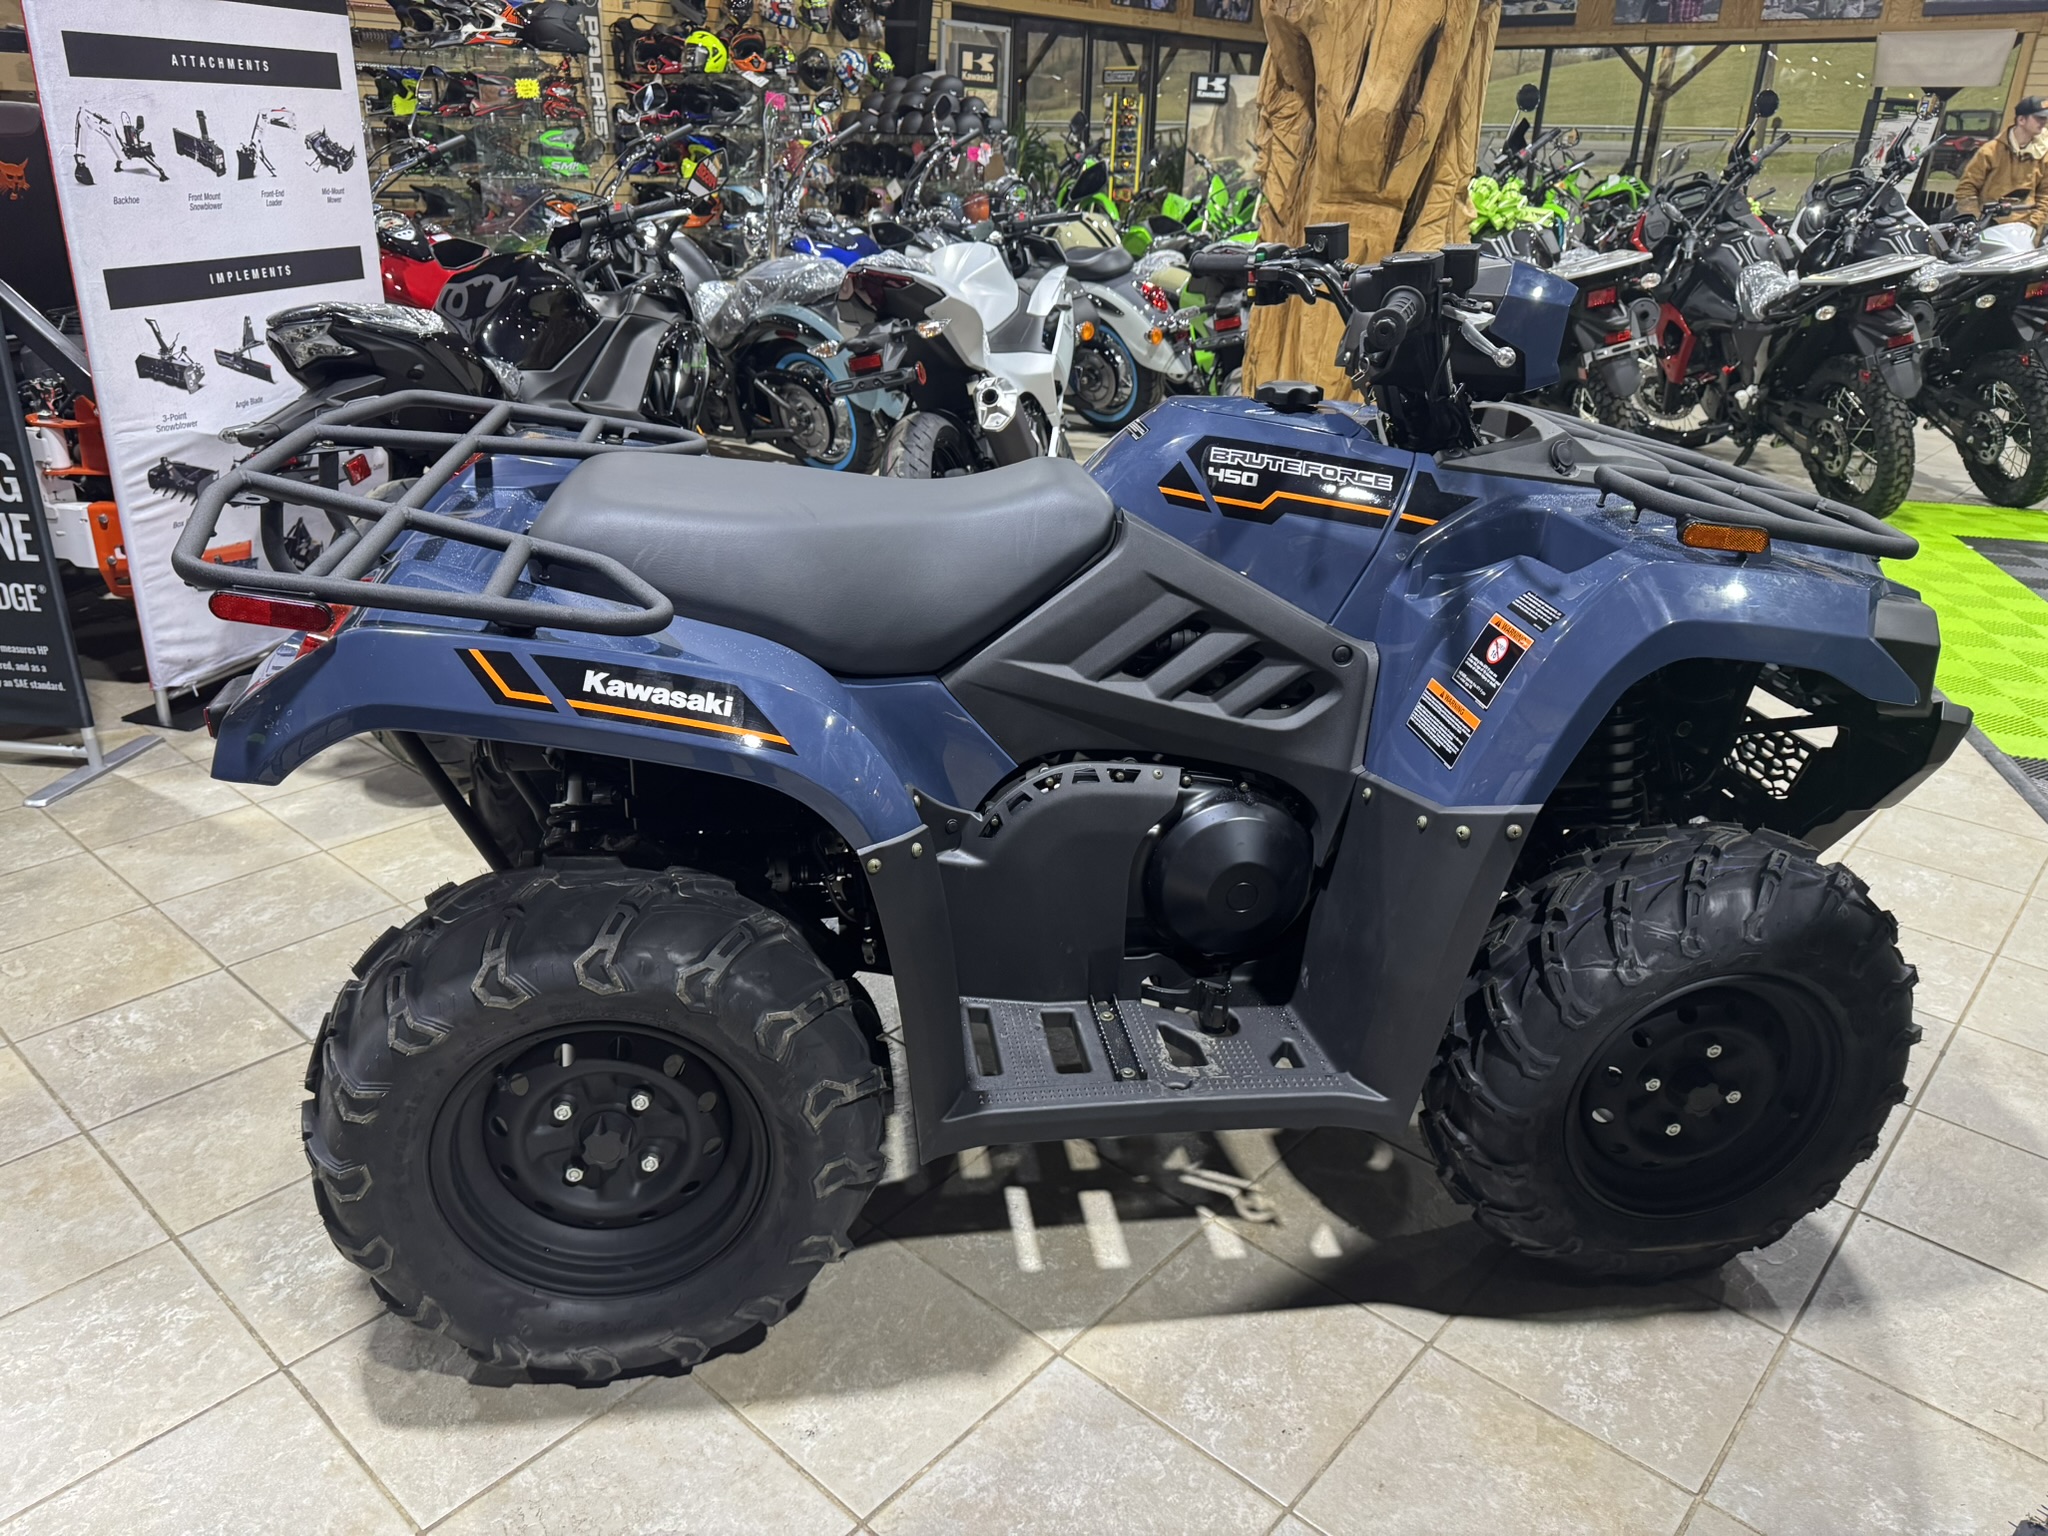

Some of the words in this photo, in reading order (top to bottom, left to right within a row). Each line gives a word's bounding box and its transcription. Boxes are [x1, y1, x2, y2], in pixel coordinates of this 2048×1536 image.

[171, 53, 270, 72] ATTACHMENTS
[584, 15, 609, 140] POLARIS
[188, 193, 203, 202] Front
[204, 192, 221, 201] Mount
[261, 189, 285, 198] Front-End
[113, 196, 140, 205] Backhoe
[265, 199, 283, 207] Loader
[189, 203, 223, 211] Snowblower
[209, 264, 292, 285] IMPLEMENTS
[235, 400, 249, 409] Angle
[162, 412, 187, 423] 3-Point
[155, 421, 198, 433] Snowblower
[1207, 467, 1259, 487] 450
[172, 521, 185, 529] Box
[36, 645, 49, 656] HP
[15, 662, 30, 672] and
[31, 664, 41, 672] as
[41, 665, 47, 673] a
[3, 680, 14, 688] an
[13, 678, 29, 689] SAE
[29, 680, 67, 692] standard.
[582, 669, 734, 718] Kawasaki
[1444, 693, 1466, 716] WARNING
